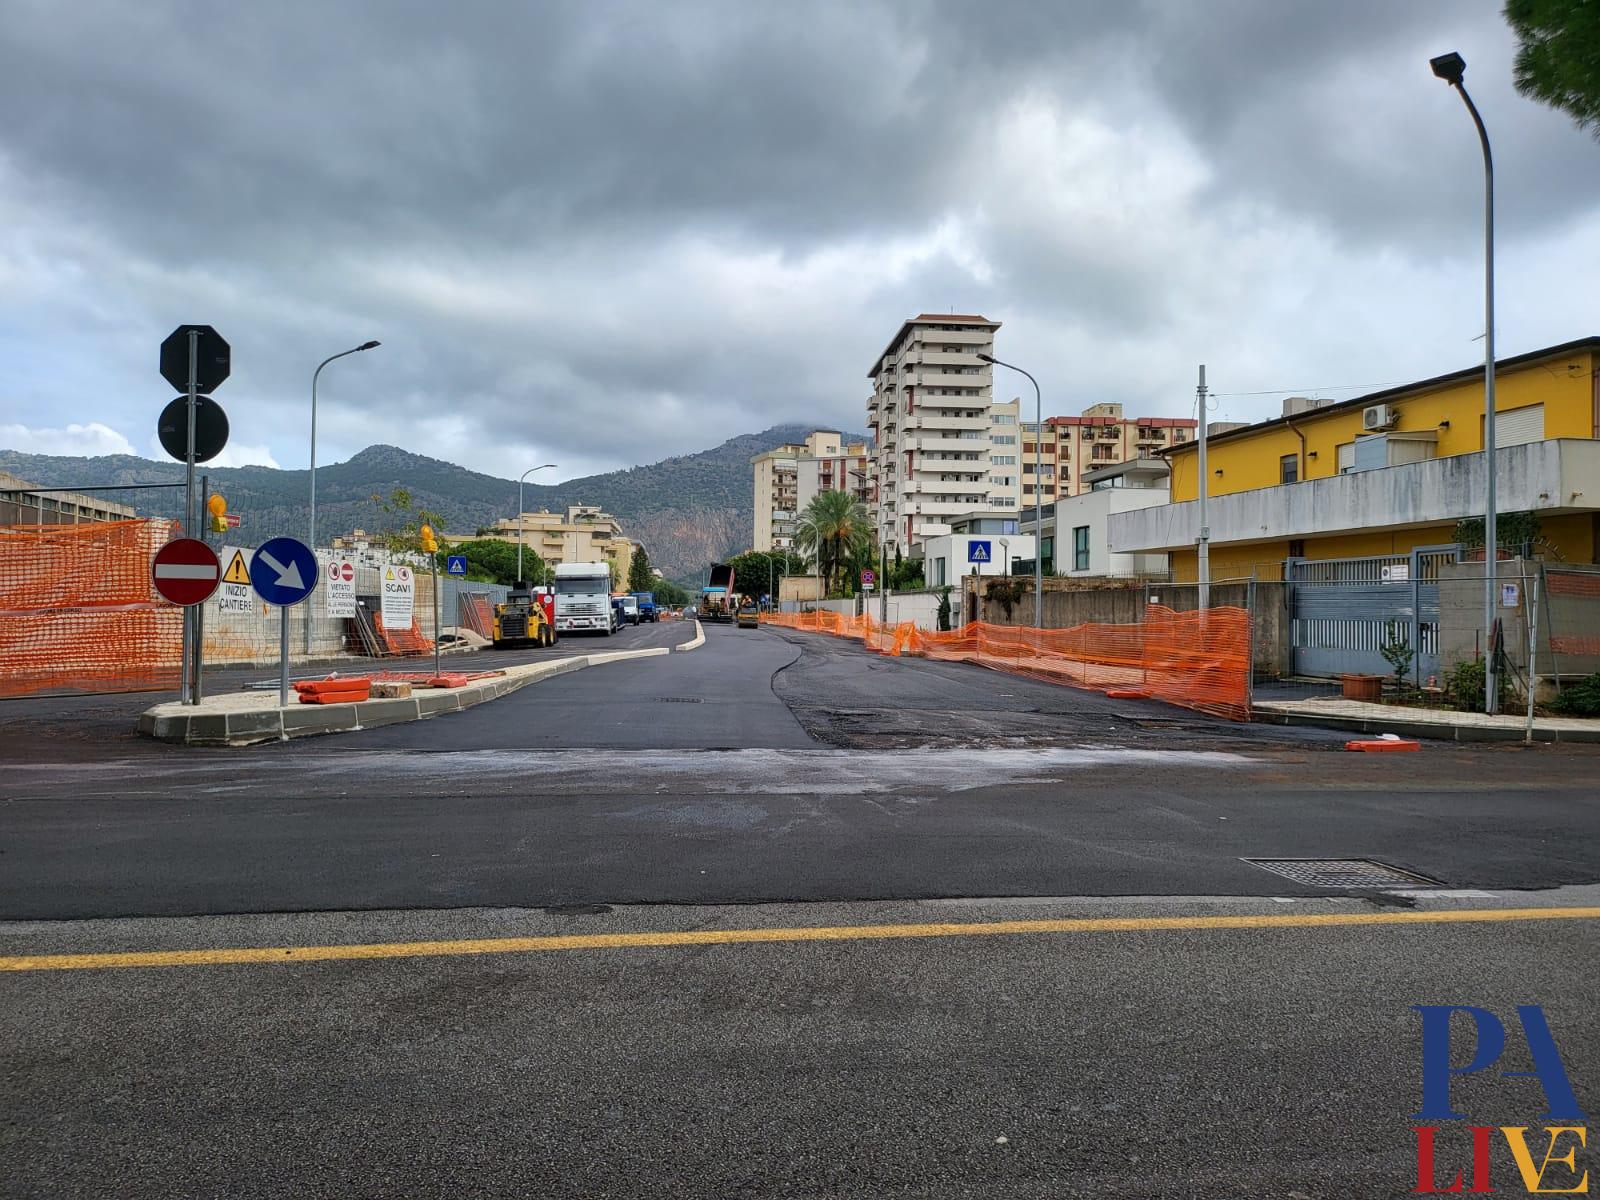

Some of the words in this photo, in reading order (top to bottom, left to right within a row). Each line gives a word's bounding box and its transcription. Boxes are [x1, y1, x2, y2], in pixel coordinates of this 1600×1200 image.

[225, 584, 247, 597] INIZIO
[385, 583, 411, 592] SCAVI
[220, 598, 252, 611] CANTIERE
